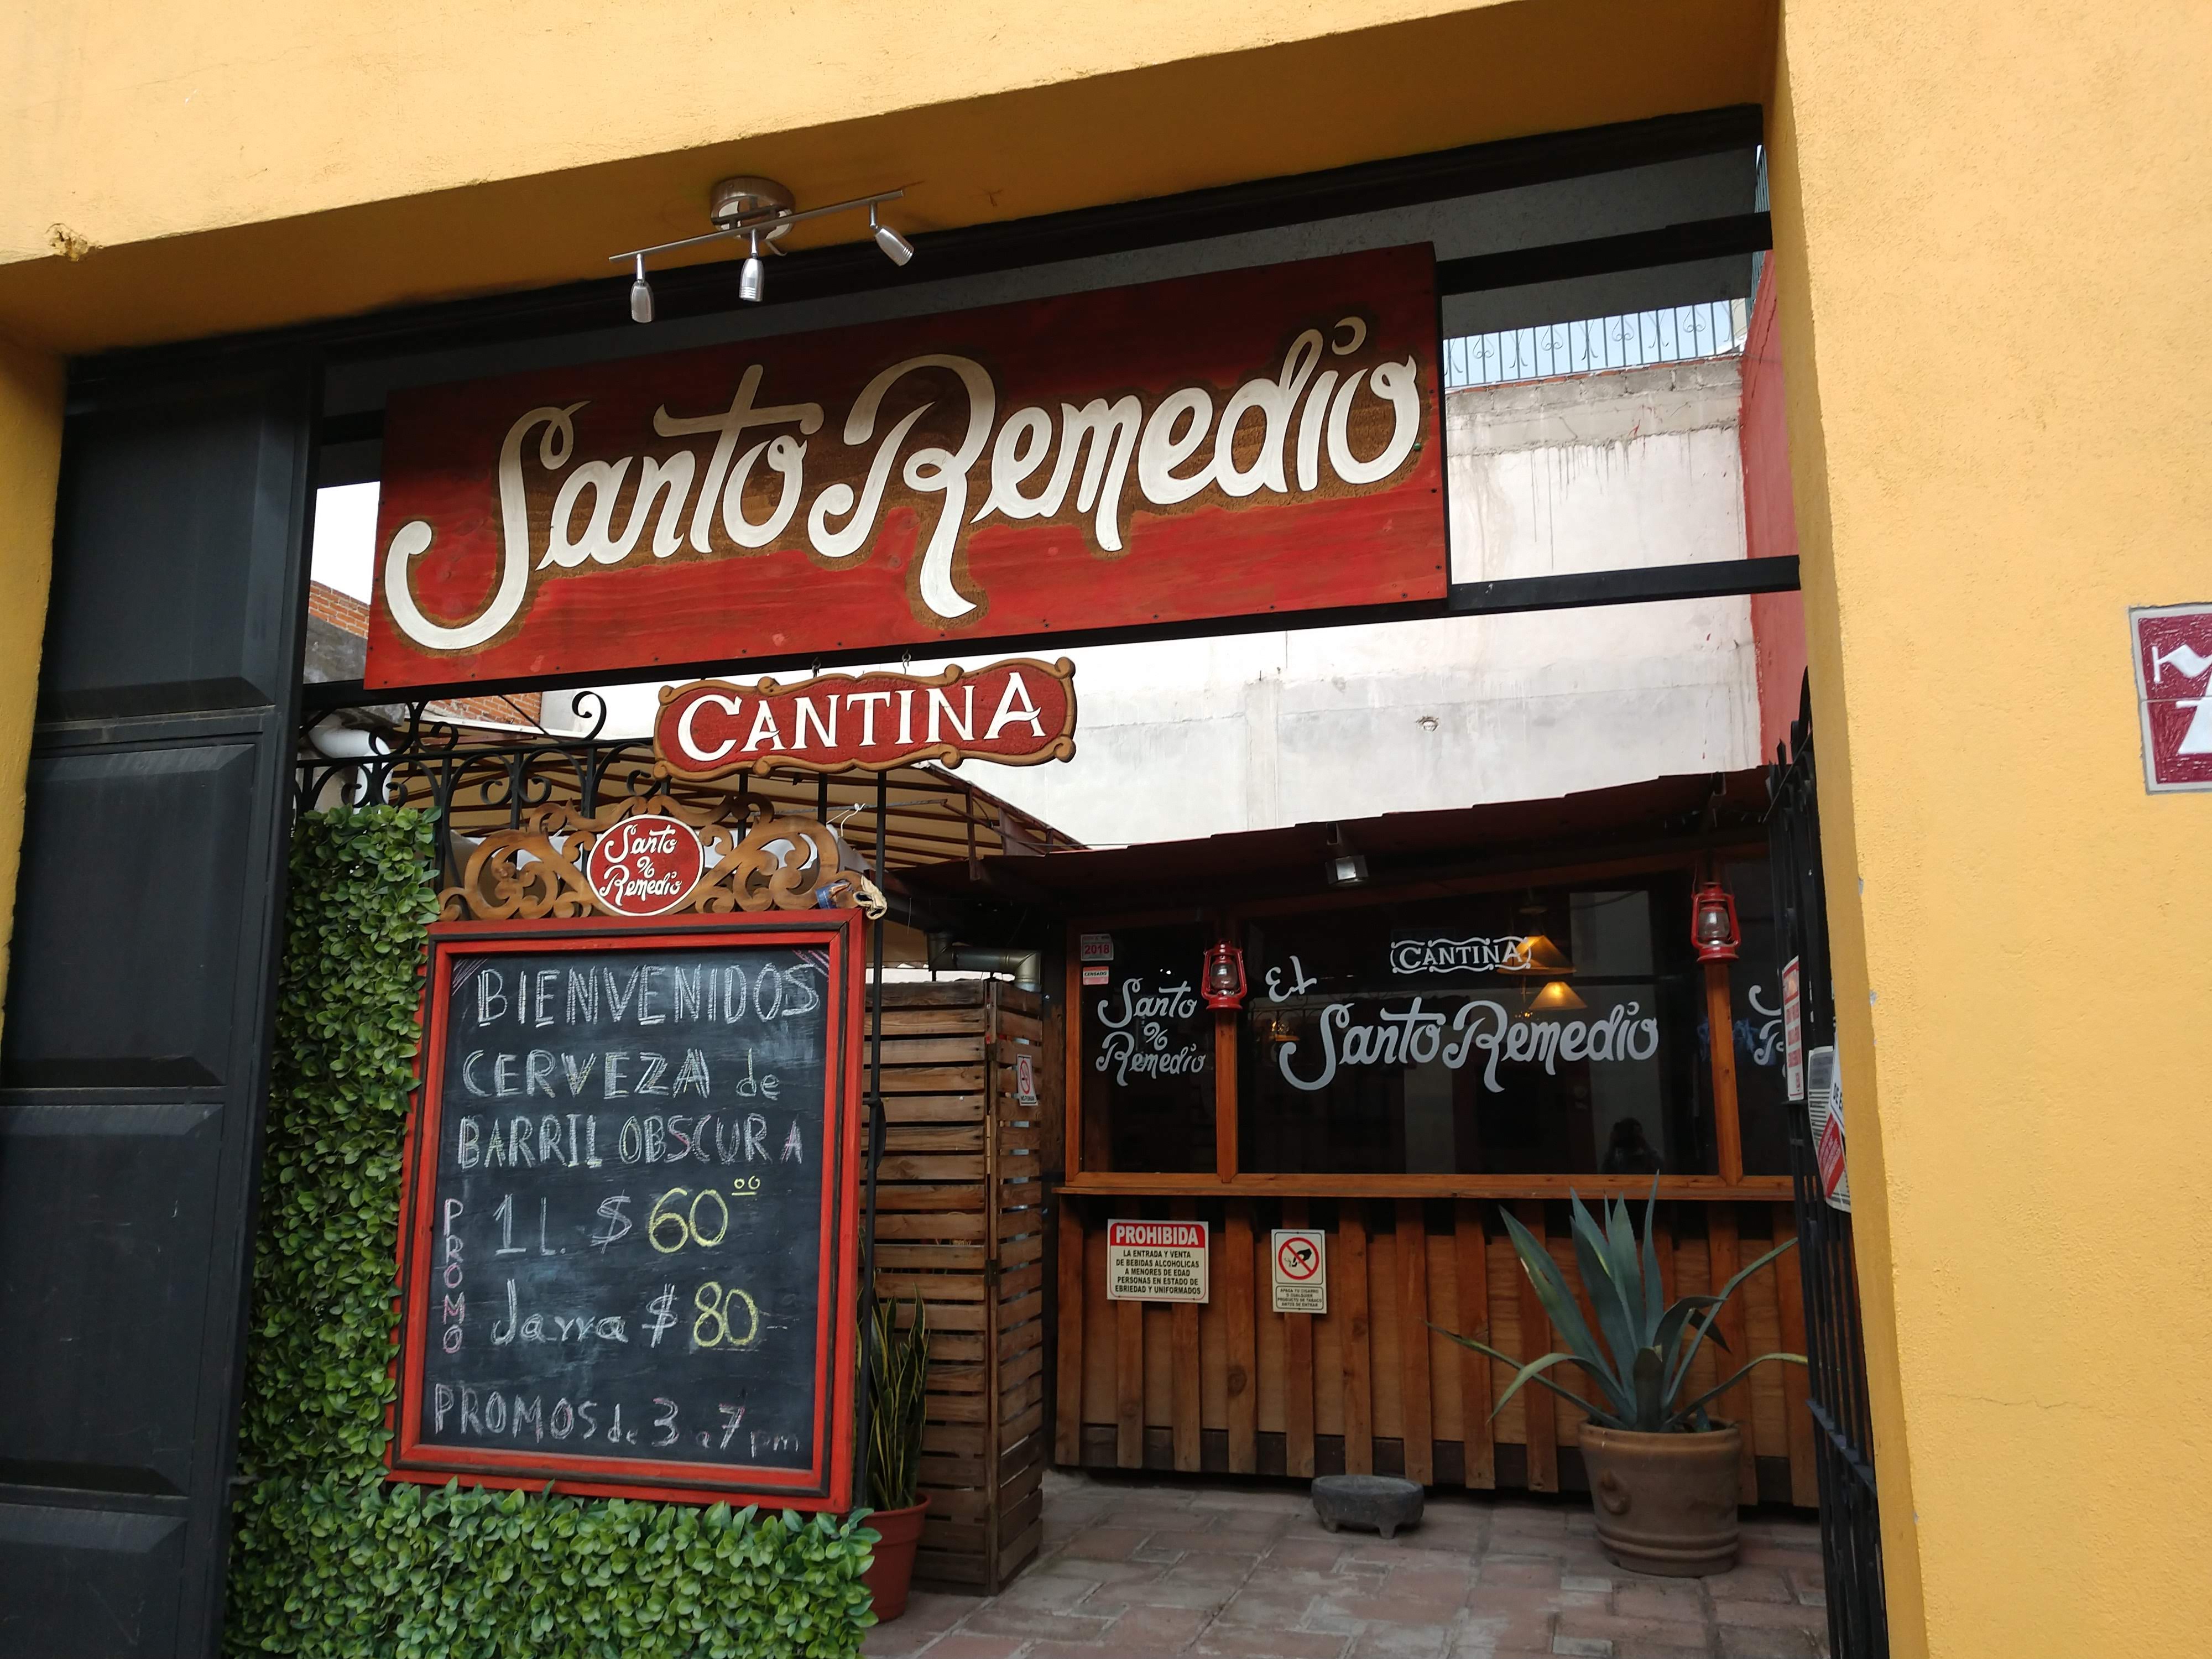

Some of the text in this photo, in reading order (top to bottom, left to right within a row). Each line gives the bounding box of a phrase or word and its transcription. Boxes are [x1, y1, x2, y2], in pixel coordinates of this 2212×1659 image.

[385, 317, 1420, 650] Santo Remedio
[677, 672, 1045, 762] CANTINA
[604, 824, 677, 863] Santo
[599, 865, 682, 906] Remedio
[1084, 944, 1109, 954] 2018
[1399, 941, 1524, 969] CANTINA
[477, 963, 820, 1027] BIENVENIDOS
[1098, 978, 1197, 1028] Santo
[1095, 1031, 1206, 1086] Remedio
[1279, 997, 1447, 1091] Santo
[1442, 1000, 1658, 1093] Remedio
[463, 1048, 781, 1099] CERVEZA de
[458, 1114, 804, 1168] BARRIL OBSCURA
[1116, 1225, 1199, 1245] PROHIBIDA
[491, 1279, 628, 1345] Jarra
[1154, 1286, 1201, 1295] UNIFORMADOS
[435, 1383, 597, 1443] PROMOS
[651, 1397, 679, 1447] 3
[719, 1403, 745, 1451] 7
